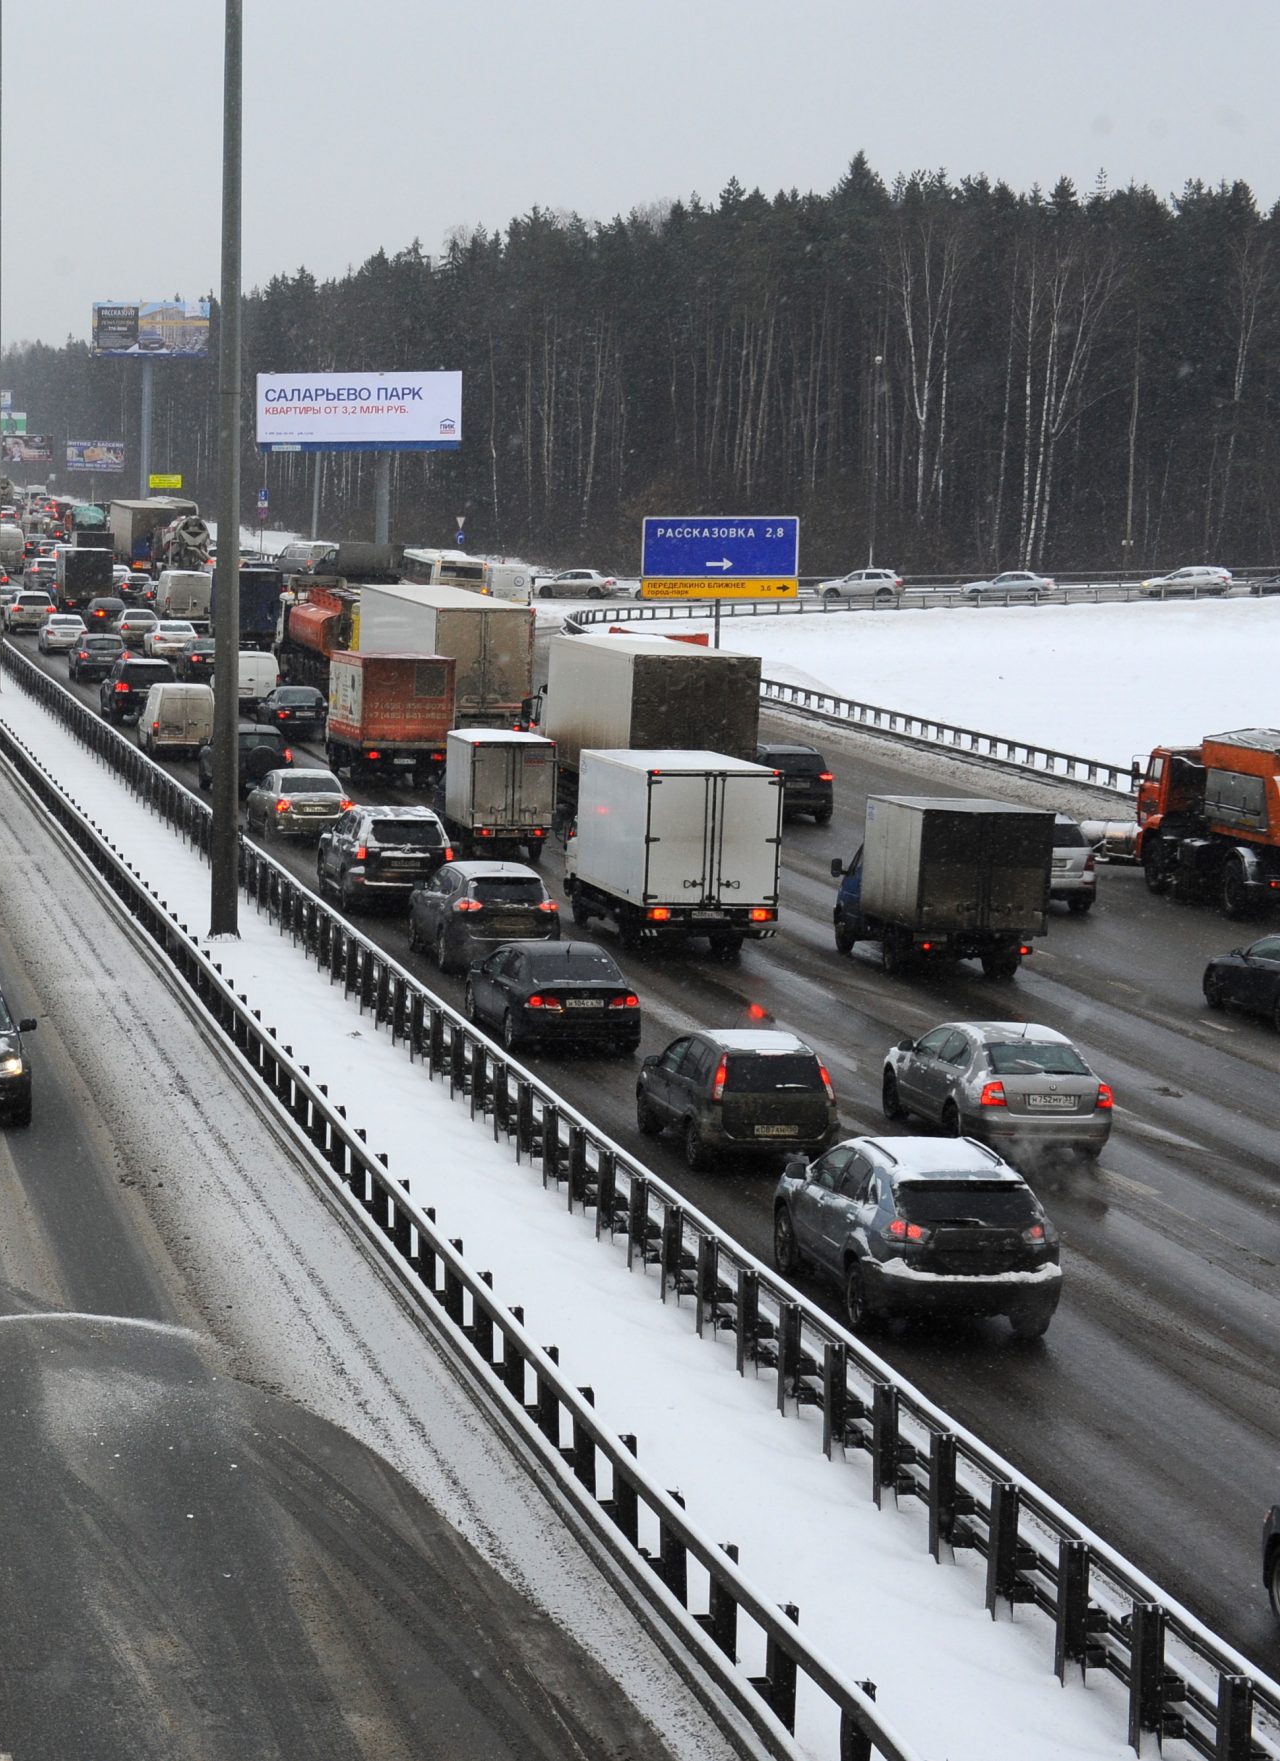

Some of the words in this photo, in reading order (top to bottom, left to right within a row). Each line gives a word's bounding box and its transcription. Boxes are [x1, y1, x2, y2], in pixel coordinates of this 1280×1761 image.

[264, 387, 371, 402] САЛАРЬЕВО
[376, 386, 423, 401] ПАРК
[264, 406, 321, 415] КВАРТИРЫ
[323, 406, 338, 415] ОТ
[341, 405, 357, 416] 3,2
[359, 405, 384, 414] МЛН
[386, 404, 409, 414] РУБ.
[657, 528, 756, 538] РАССКАЗОВКА
[765, 527, 785, 539] 2,8
